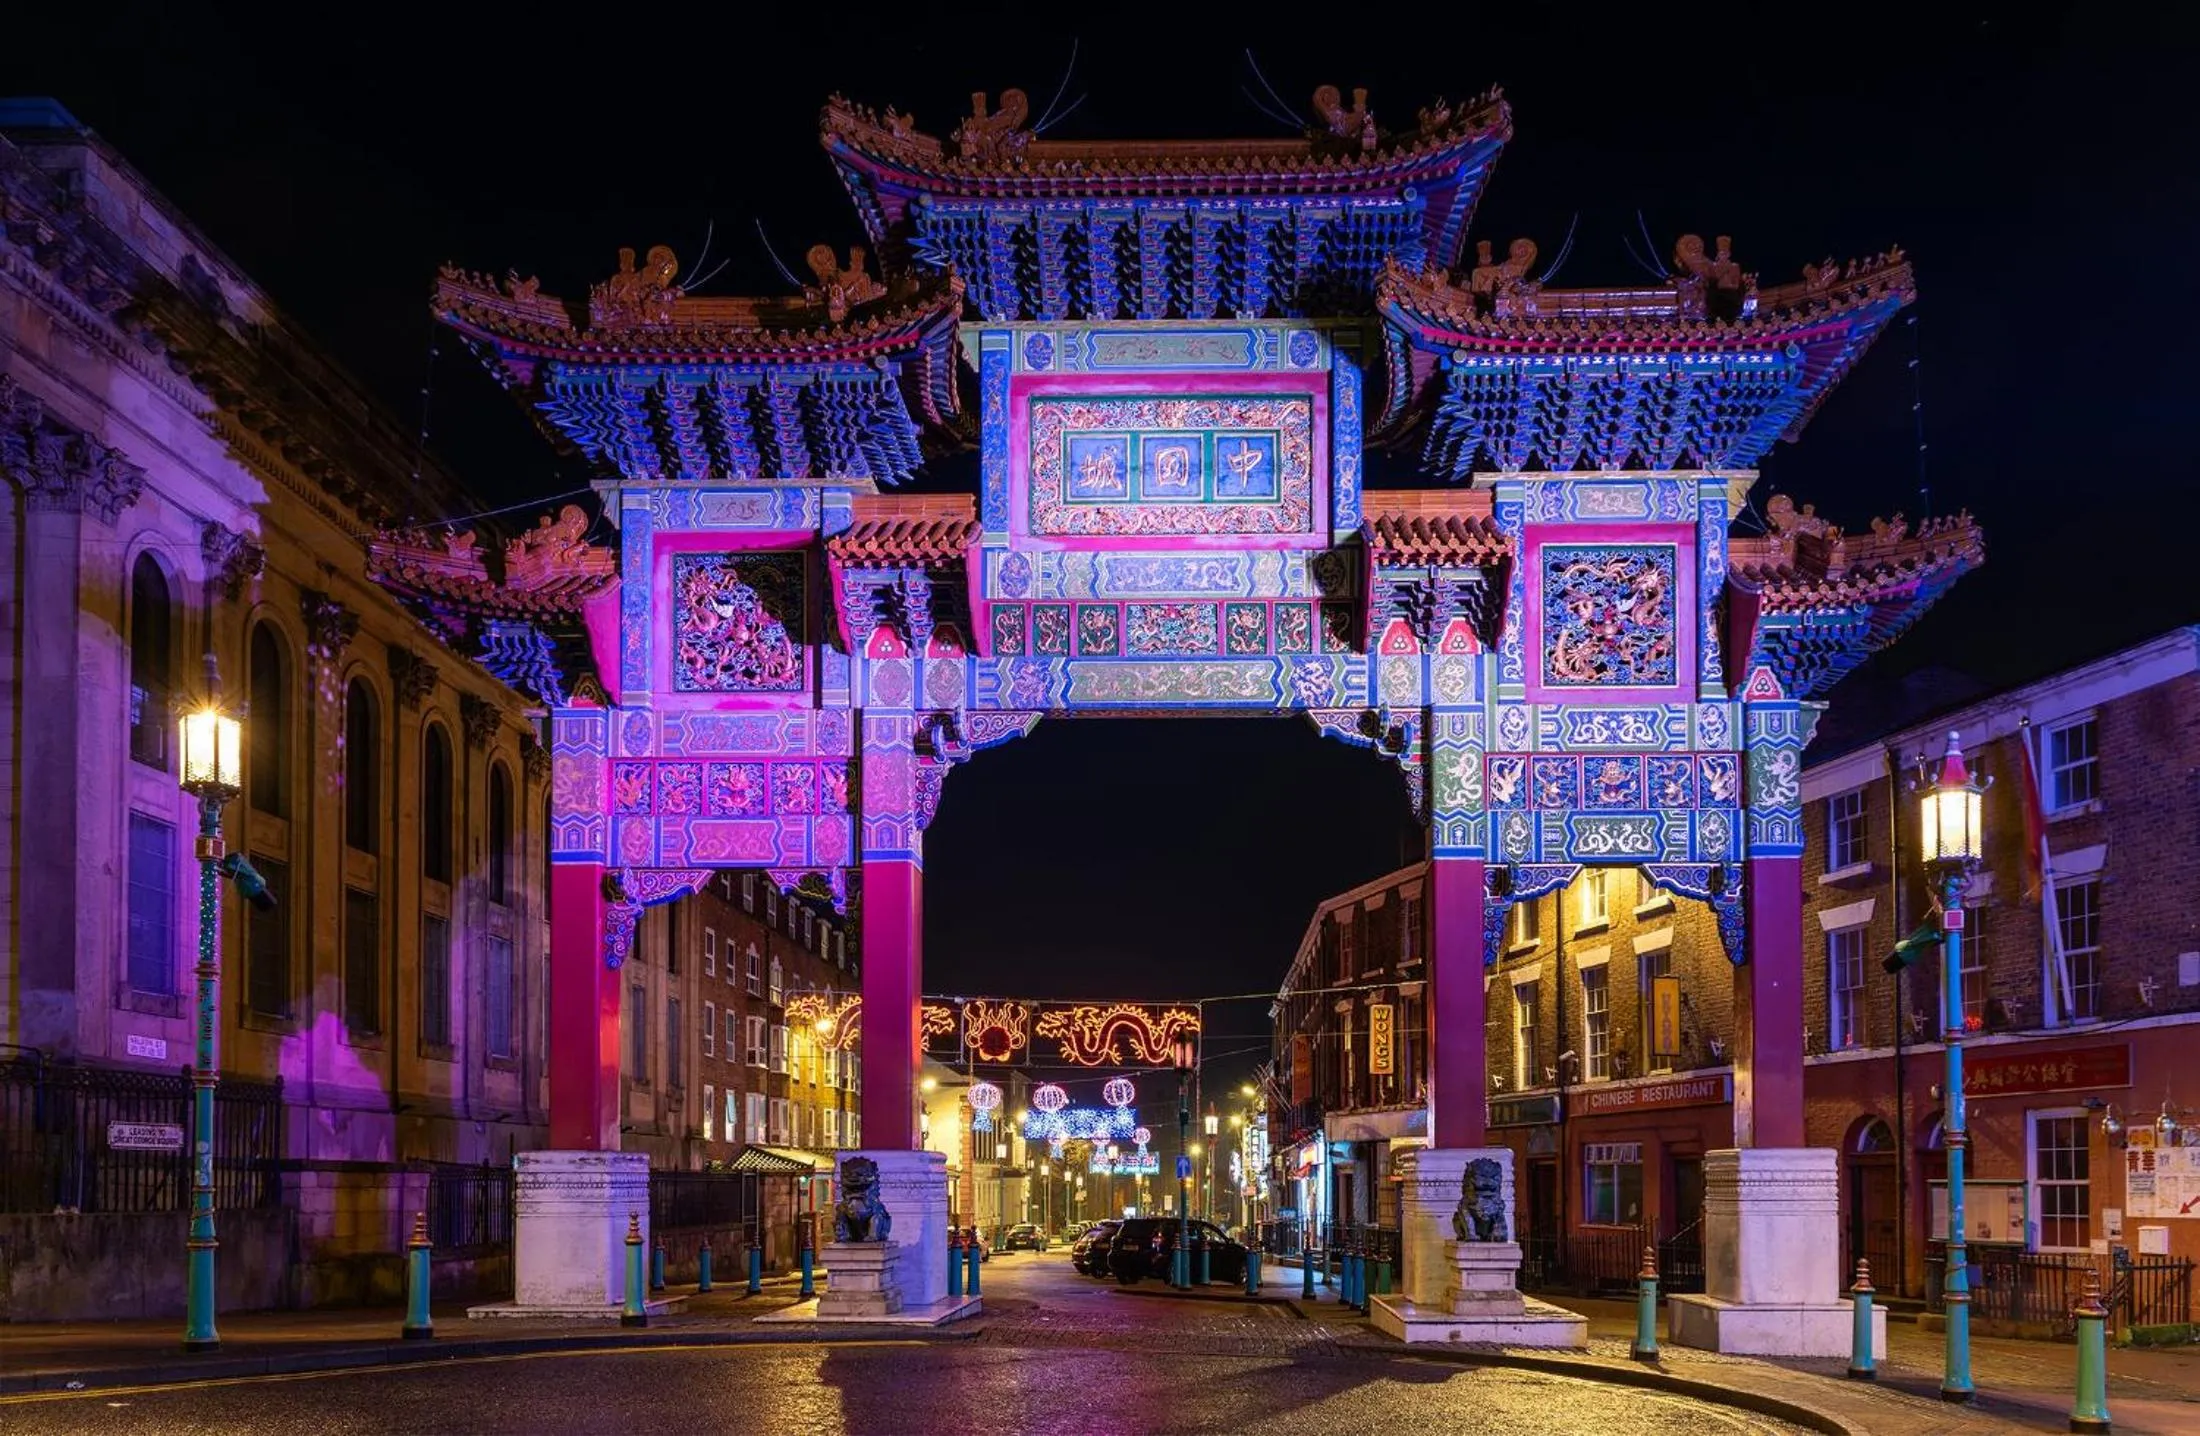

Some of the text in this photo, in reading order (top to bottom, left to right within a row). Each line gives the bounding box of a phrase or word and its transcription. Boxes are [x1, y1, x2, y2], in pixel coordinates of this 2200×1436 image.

[1374, 1007, 1390, 1069] WONGS
[1592, 1081, 1716, 1107] CHINESE RESTAURANT
